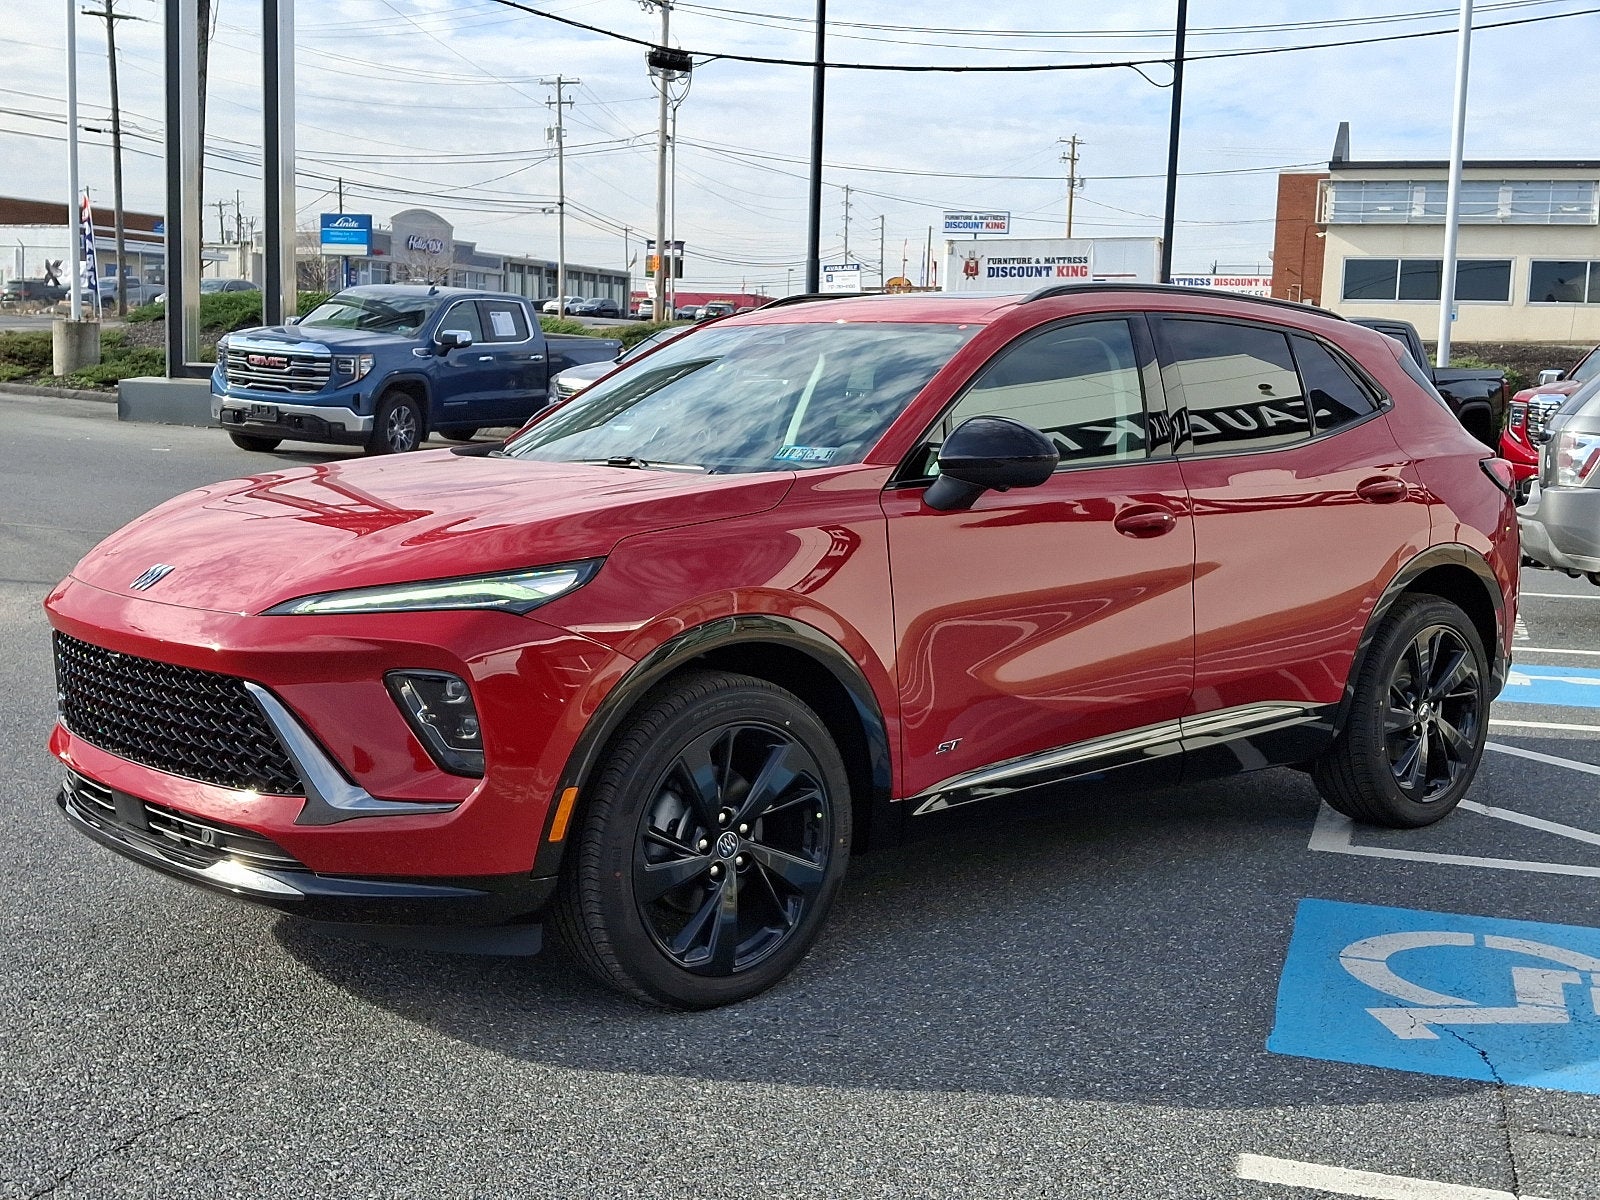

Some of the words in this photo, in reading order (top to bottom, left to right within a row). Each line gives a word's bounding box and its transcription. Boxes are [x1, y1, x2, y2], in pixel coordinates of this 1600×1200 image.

[944, 221, 984, 229] DISCOUNT
[985, 222, 1006, 230] KING
[987, 257, 1032, 265] FURNITURE
[1044, 256, 1088, 264] MATTRESS
[825, 264, 858, 272] AVAILABLE
[987, 266, 1052, 278] DISCOUNT
[1056, 265, 1088, 277] KING
[1168, 277, 1211, 286] ATTRESS
[1214, 278, 1260, 287] DISCOUNT
[248, 354, 288, 368] GMC
[935, 736, 964, 755] ST
